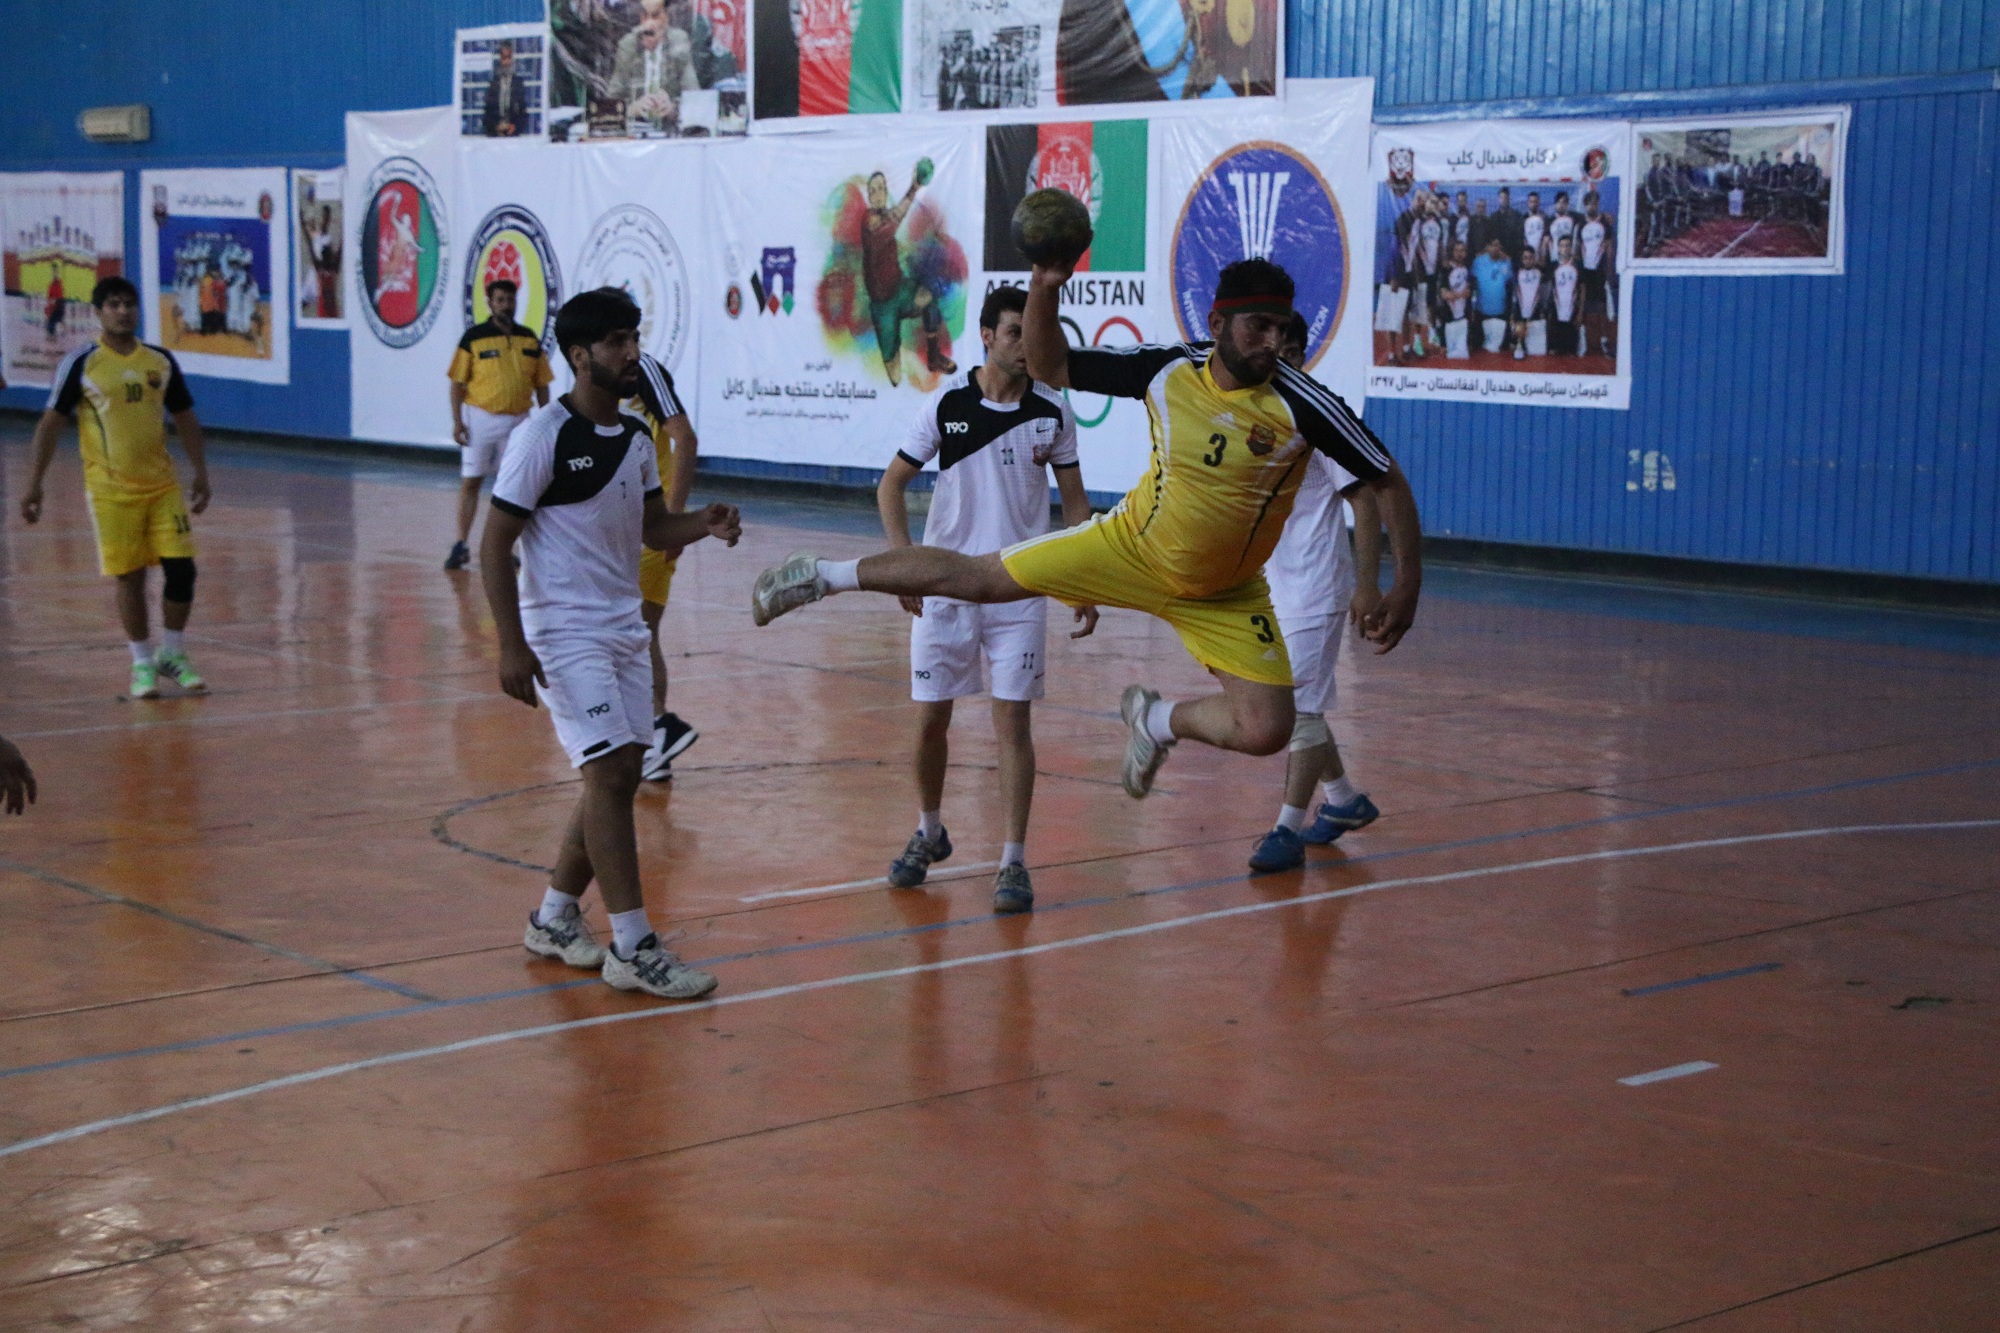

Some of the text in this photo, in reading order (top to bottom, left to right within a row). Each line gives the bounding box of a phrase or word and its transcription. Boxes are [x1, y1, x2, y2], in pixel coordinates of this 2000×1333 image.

[1447, 150, 1474, 171] کلب
[1476, 147, 1517, 170] هندبال
[985, 279, 1145, 306] ANISTAN
[125, 383, 143, 403] 10
[722, 376, 745, 401] کابل
[746, 377, 782, 401] هندبال
[822, 379, 878, 404] مسابقات
[1396, 376, 1418, 392] سال
[1427, 377, 1479, 392] افغانستان
[1480, 380, 1516, 396] هندبال
[1569, 382, 1608, 401] قهرمان
[943, 421, 970, 435] T90
[1001, 448, 1015, 465] 11
[1203, 432, 1228, 467] 3
[567, 455, 594, 472] T90
[1250, 614, 1275, 644] 3
[1021, 652, 1035, 670] 11
[586, 702, 611, 719] T90
